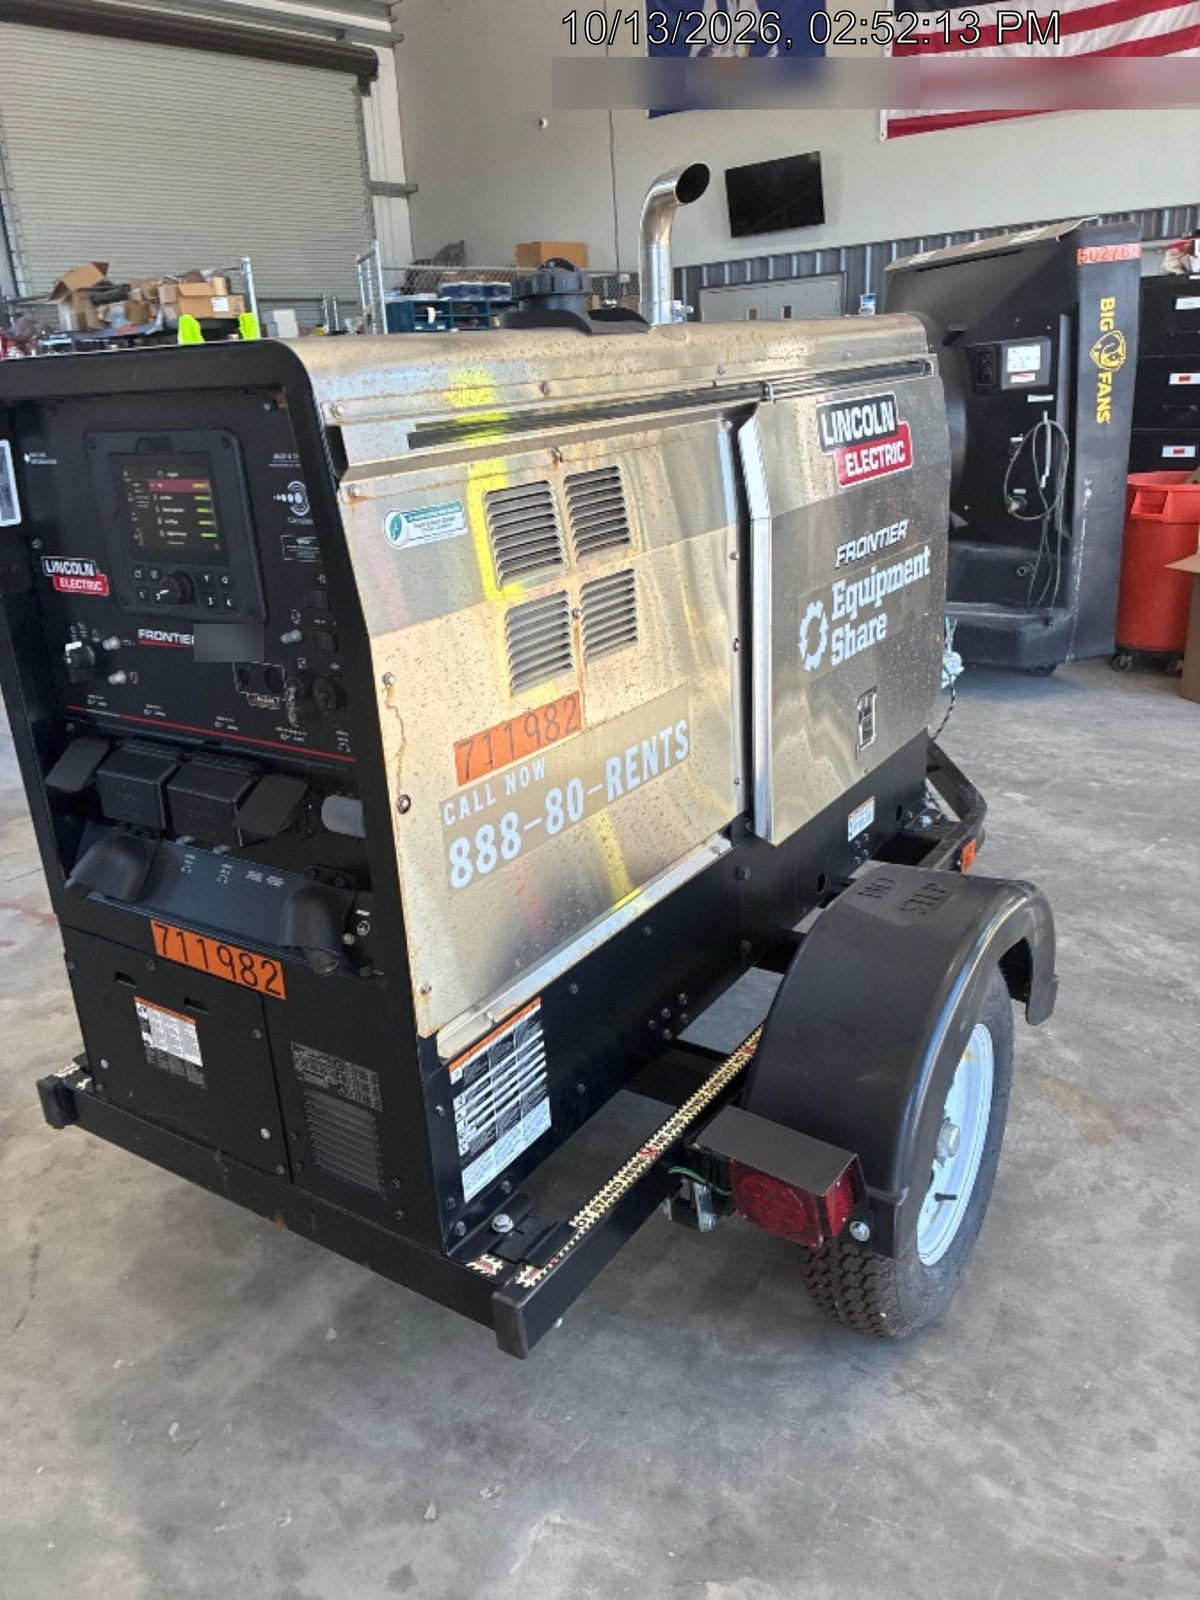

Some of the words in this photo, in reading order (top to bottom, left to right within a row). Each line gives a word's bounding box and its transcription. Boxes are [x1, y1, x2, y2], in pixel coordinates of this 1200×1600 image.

[1099, 297, 1116, 331] BIG
[1096, 372, 1113, 424] FANS
[820, 401, 896, 446] LINCOLN
[845, 441, 906, 477] ELECTRIC
[45, 559, 95, 577] LINCOLN
[835, 519, 909, 569] FRONTIER
[59, 577, 103, 591] ELECTRIC
[831, 546, 931, 621] Equipment
[138, 629, 194, 645] FRONTIE
[830, 612, 887, 667] Share
[457, 697, 580, 781] 711982
[443, 784, 497, 826] CALL
[505, 757, 546, 796] NOW
[448, 719, 690, 889] 888-80-RENTS
[154, 922, 283, 997] 711982
[590, 1182, 623, 1212] STAND
